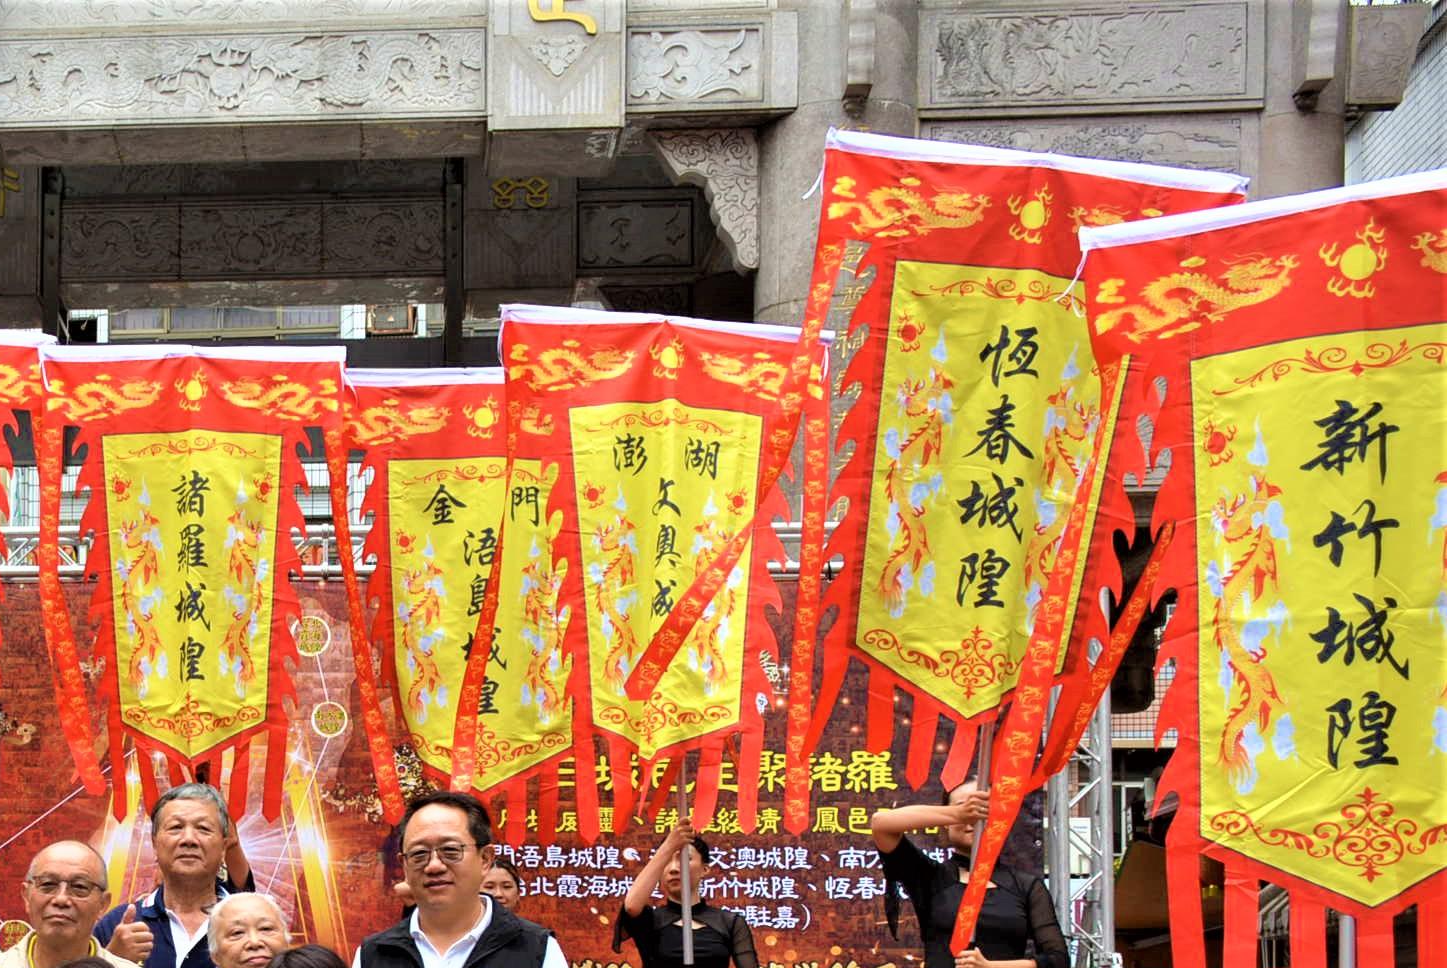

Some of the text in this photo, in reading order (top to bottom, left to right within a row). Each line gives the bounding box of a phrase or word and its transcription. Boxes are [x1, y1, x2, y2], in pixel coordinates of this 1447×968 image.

[422, 483, 541, 527] 金門
[612, 432, 721, 481] 澎湖
[955, 324, 1039, 608] 恆春城隍
[170, 469, 212, 683] 諸羅城隍
[1299, 399, 1410, 770] 新竹城隍
